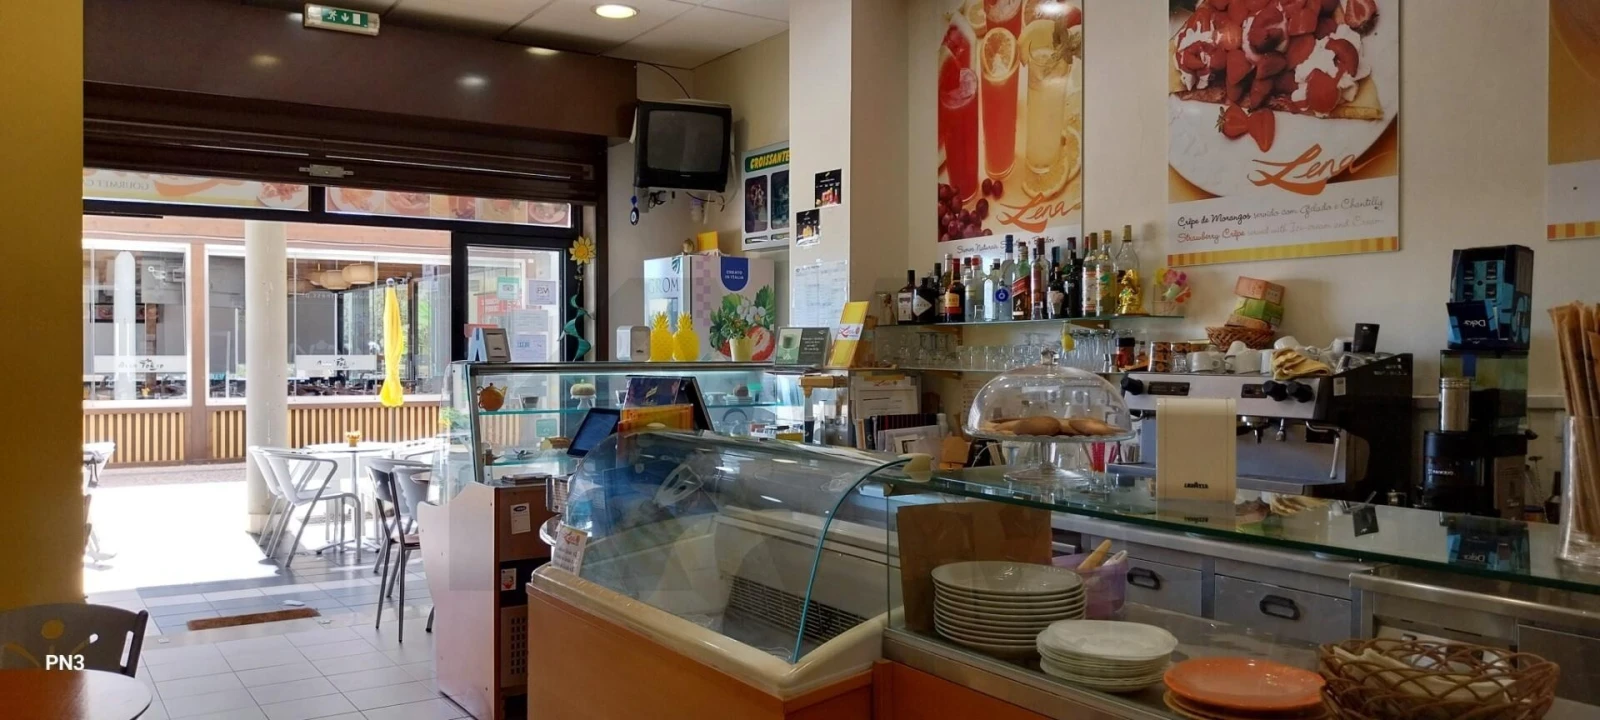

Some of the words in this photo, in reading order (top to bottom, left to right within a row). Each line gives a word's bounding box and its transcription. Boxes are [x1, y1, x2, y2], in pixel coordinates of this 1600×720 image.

[750, 149, 790, 169] CROISSANTE
[1247, 143, 1388, 196] Lena
[996, 192, 1081, 233] Lena
[1177, 216, 1199, 229] Crêpe
[1201, 215, 1209, 224] de
[1211, 213, 1252, 225] Morangos
[1340, 196, 1384, 212] Chantilly
[1177, 231, 1220, 244] Strawberry
[1222, 228, 1245, 241] Crêpe
[648, 277, 679, 293] GROM
